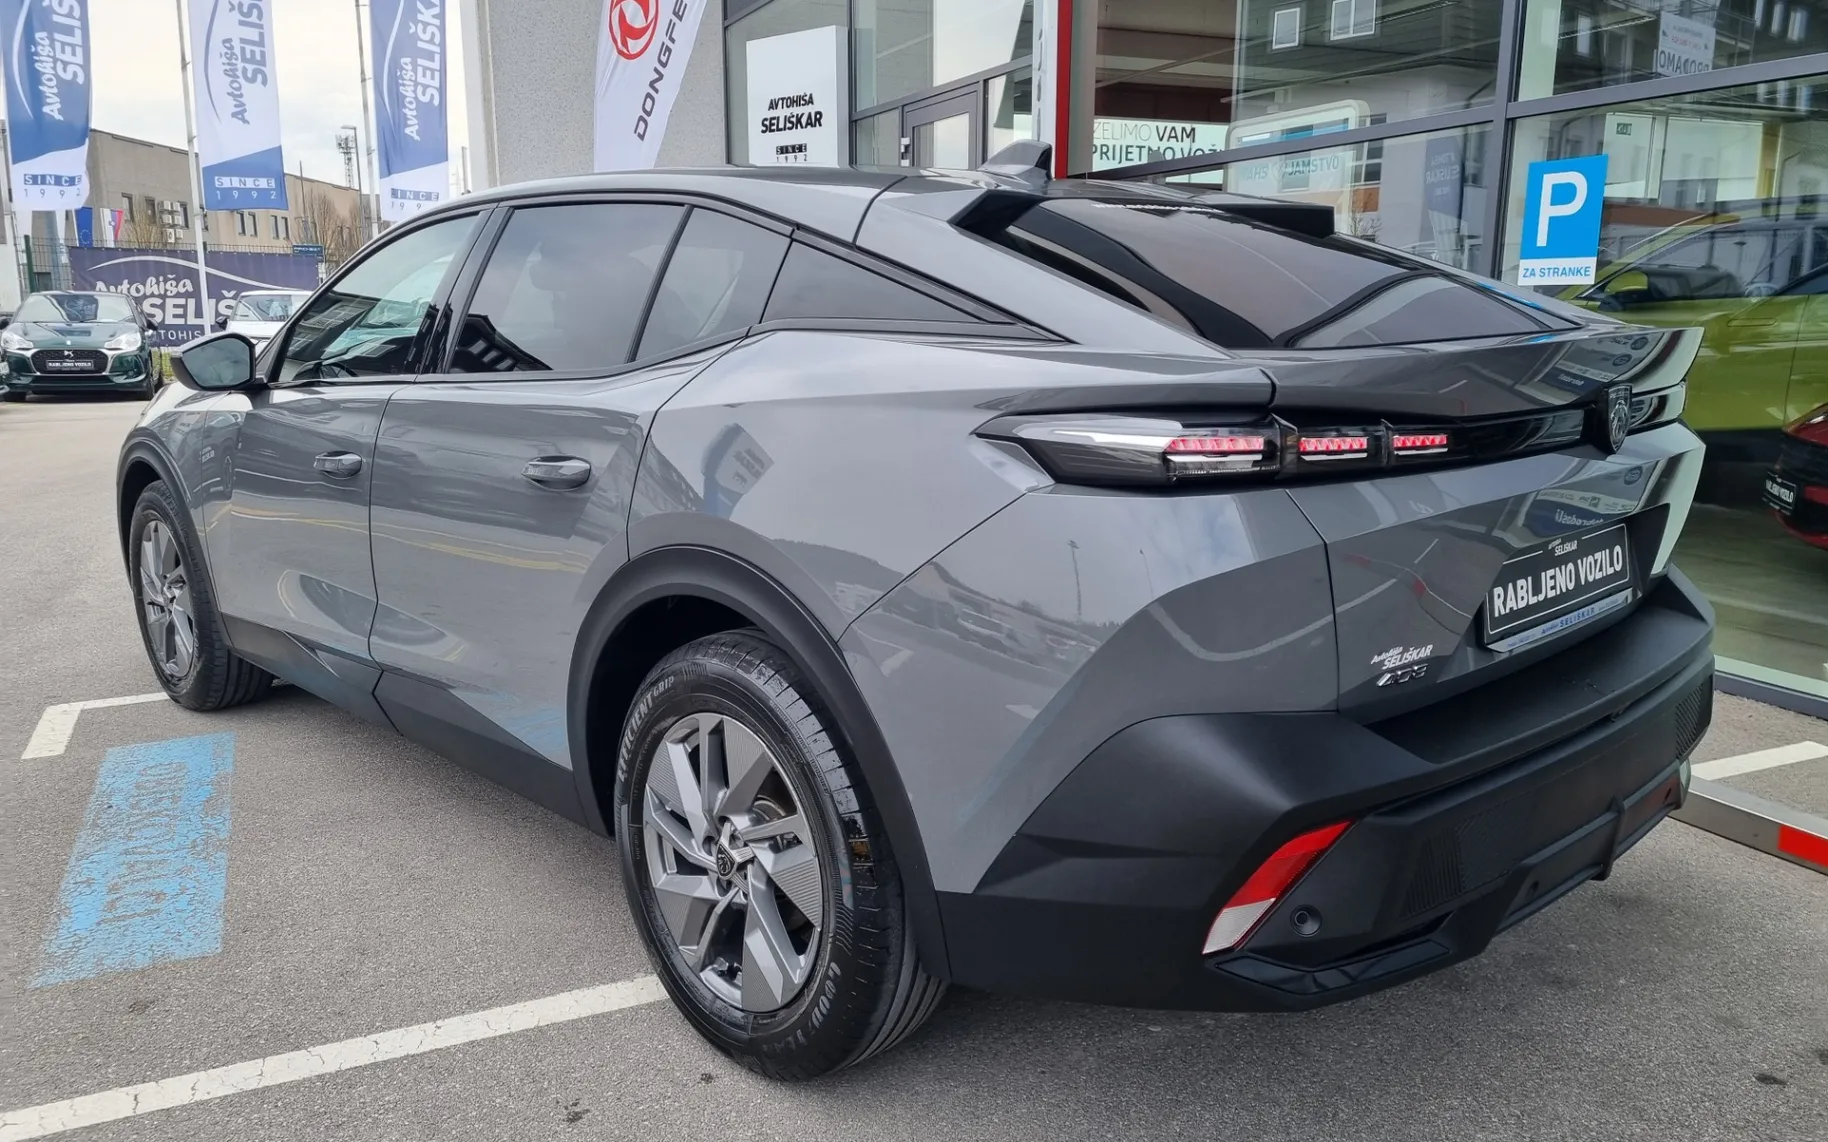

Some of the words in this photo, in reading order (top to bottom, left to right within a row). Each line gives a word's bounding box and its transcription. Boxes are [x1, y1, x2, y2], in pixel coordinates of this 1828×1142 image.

[228, 0, 268, 88] SELIŠ
[409, 0, 441, 107] SELIŠK
[219, 37, 250, 125] Avtohiša
[396, 57, 420, 141] Avtohiša
[768, 92, 814, 111] AVTOHIŠA
[761, 110, 823, 133] SELIŠKAR
[1155, 125, 1196, 143] VAM
[776, 143, 807, 155] SINCE
[1288, 155, 1340, 177] JAMSTVO
[24, 174, 82, 187] SINCE
[215, 177, 275, 189] SINCE
[24, 188, 82, 198] 1992
[216, 190, 277, 200] 1992
[1536, 171, 1588, 247] P
[1522, 267, 1536, 278] ZA
[1539, 266, 1592, 278] STRANKE
[94, 274, 194, 297] Avtohiša
[1493, 562, 1576, 617] RABLJENO
[1578, 544, 1623, 586] VOZILO
